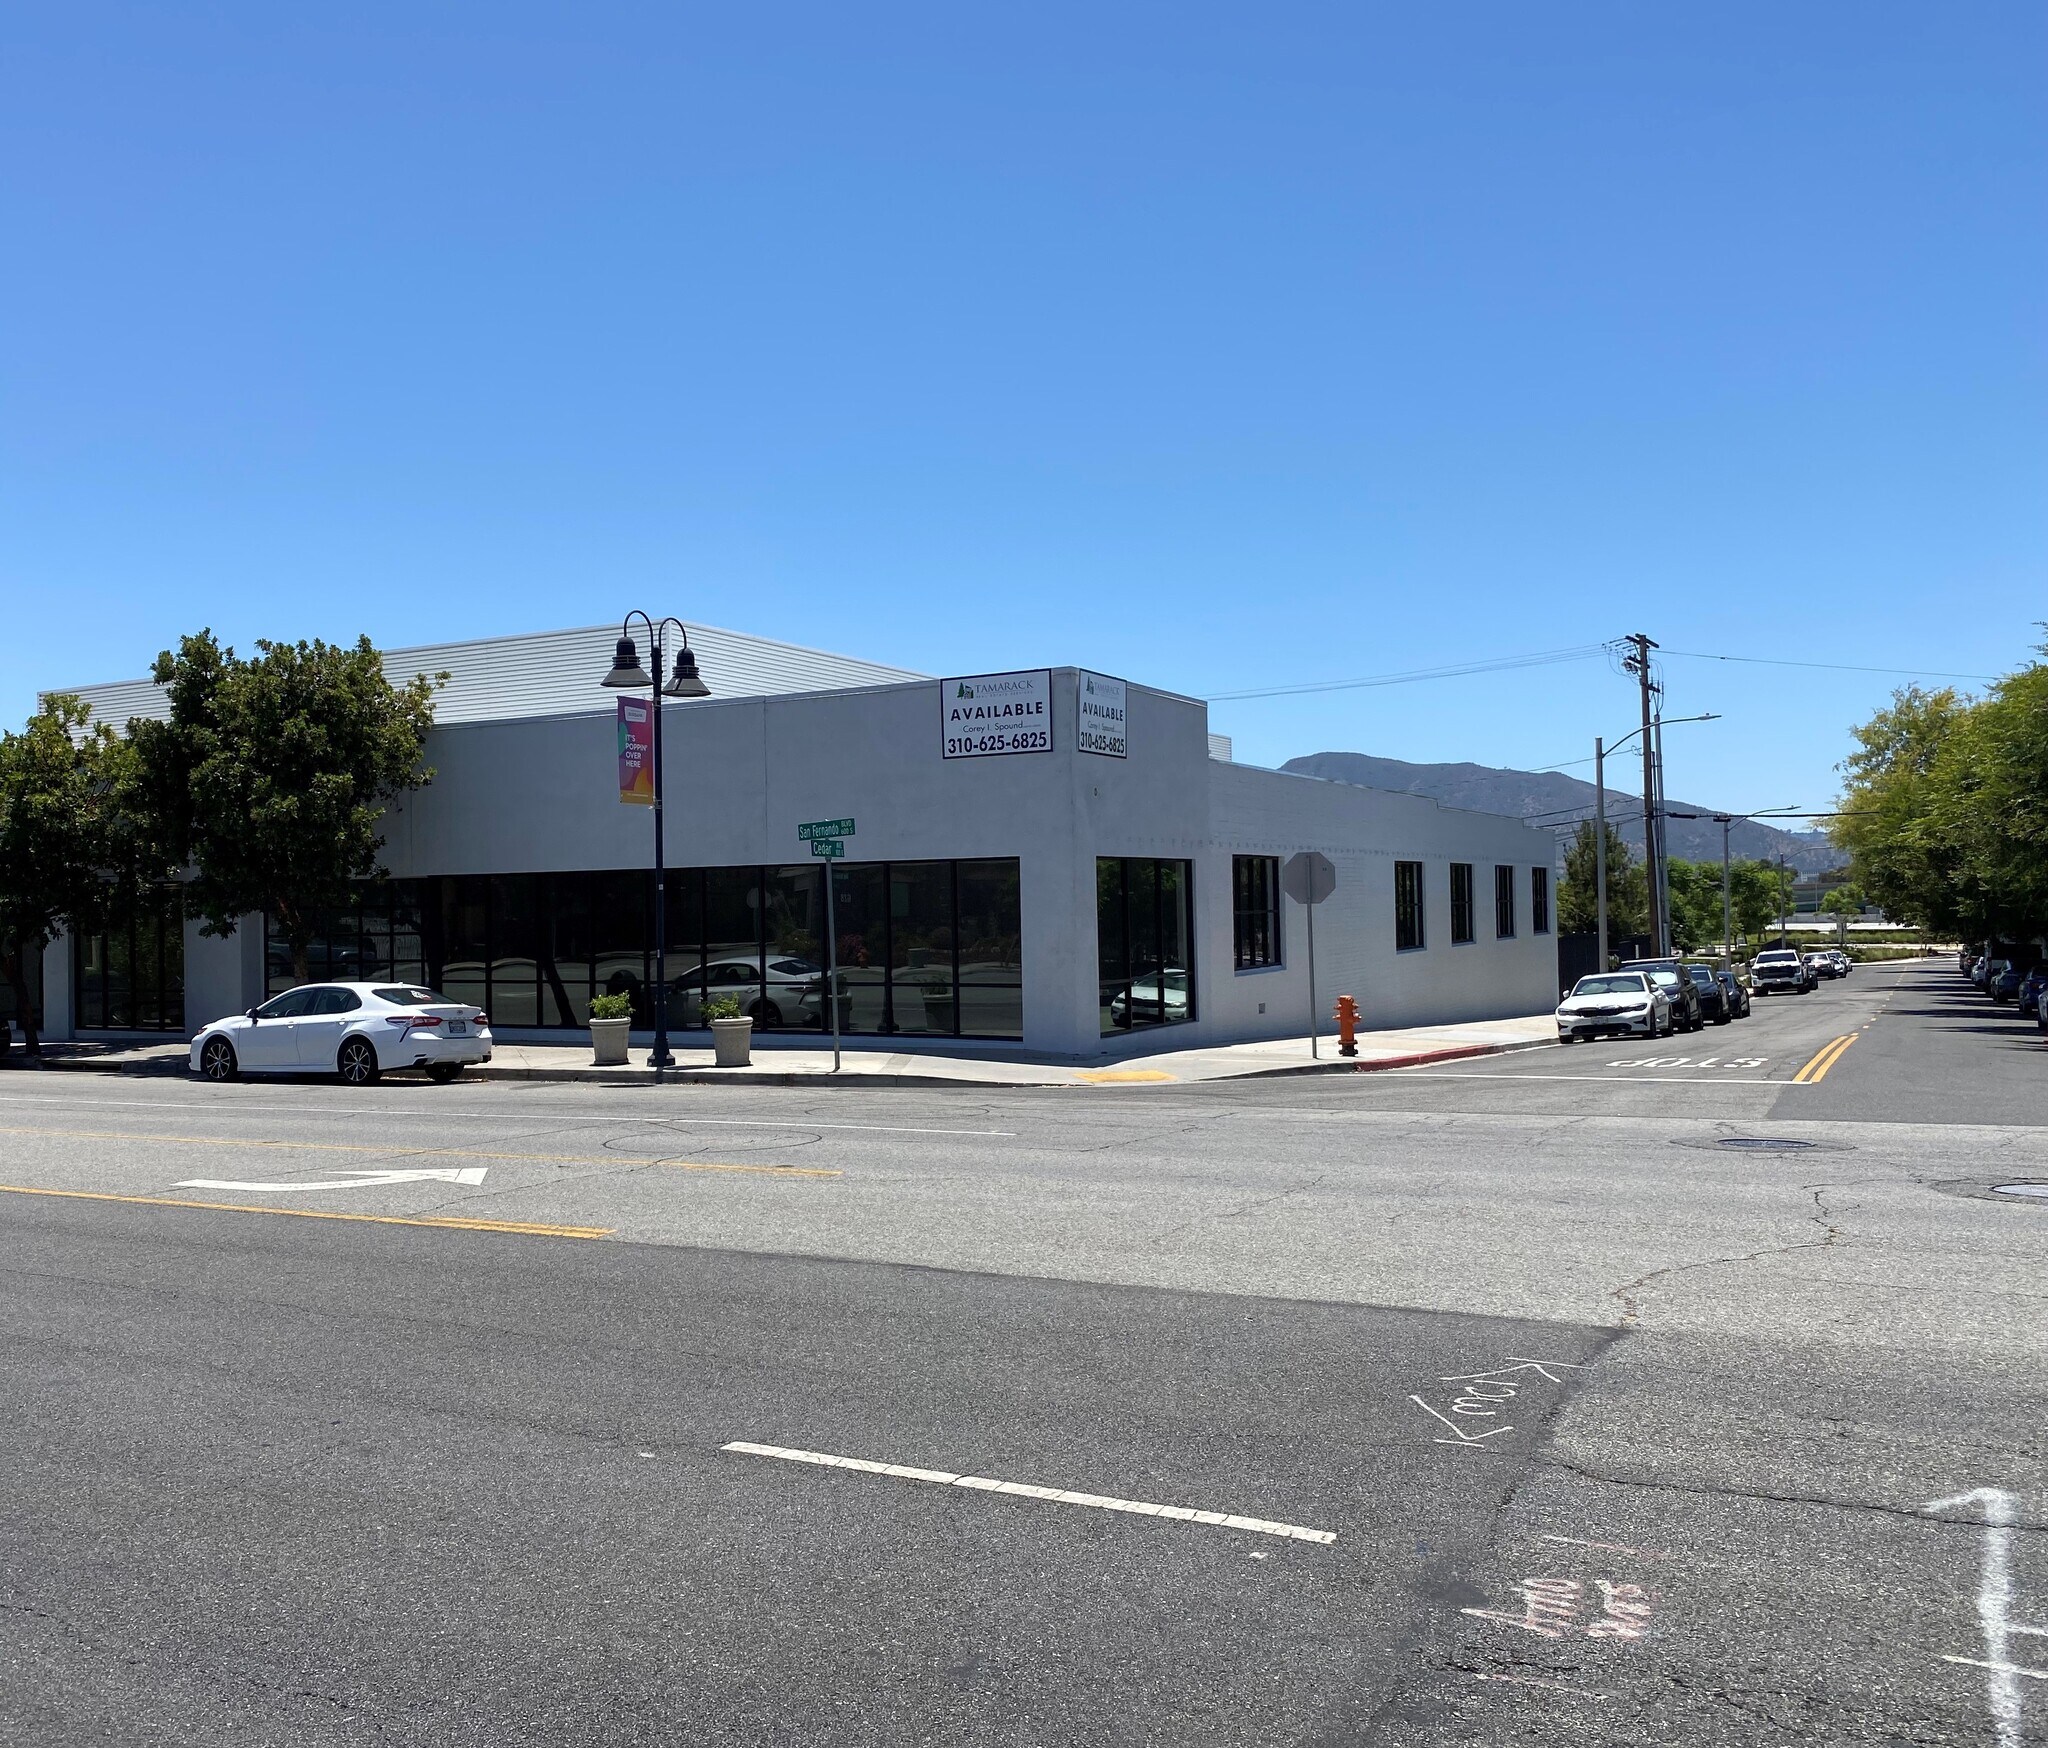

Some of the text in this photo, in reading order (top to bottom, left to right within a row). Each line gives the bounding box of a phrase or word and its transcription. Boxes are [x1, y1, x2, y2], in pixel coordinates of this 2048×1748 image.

[975, 680, 1034, 693] TAMARACK
[950, 701, 1043, 722] AVAILABLE
[1082, 702, 1124, 722] AVAILABLE
[963, 725, 985, 734] Corey
[994, 720, 1024, 732] Spound
[625, 734, 636, 742] IT'S
[947, 732, 1047, 754] 310-625-6825
[1081, 732, 1125, 754] 310-625-6825
[625, 743, 648, 752] POPPIN'
[625, 751, 642, 760] OVER
[625, 760, 641, 768] HERE
[800, 823, 839, 839] San Fernando
[813, 841, 832, 855] Cedar
[1605, 1057, 1769, 1069] STOP
